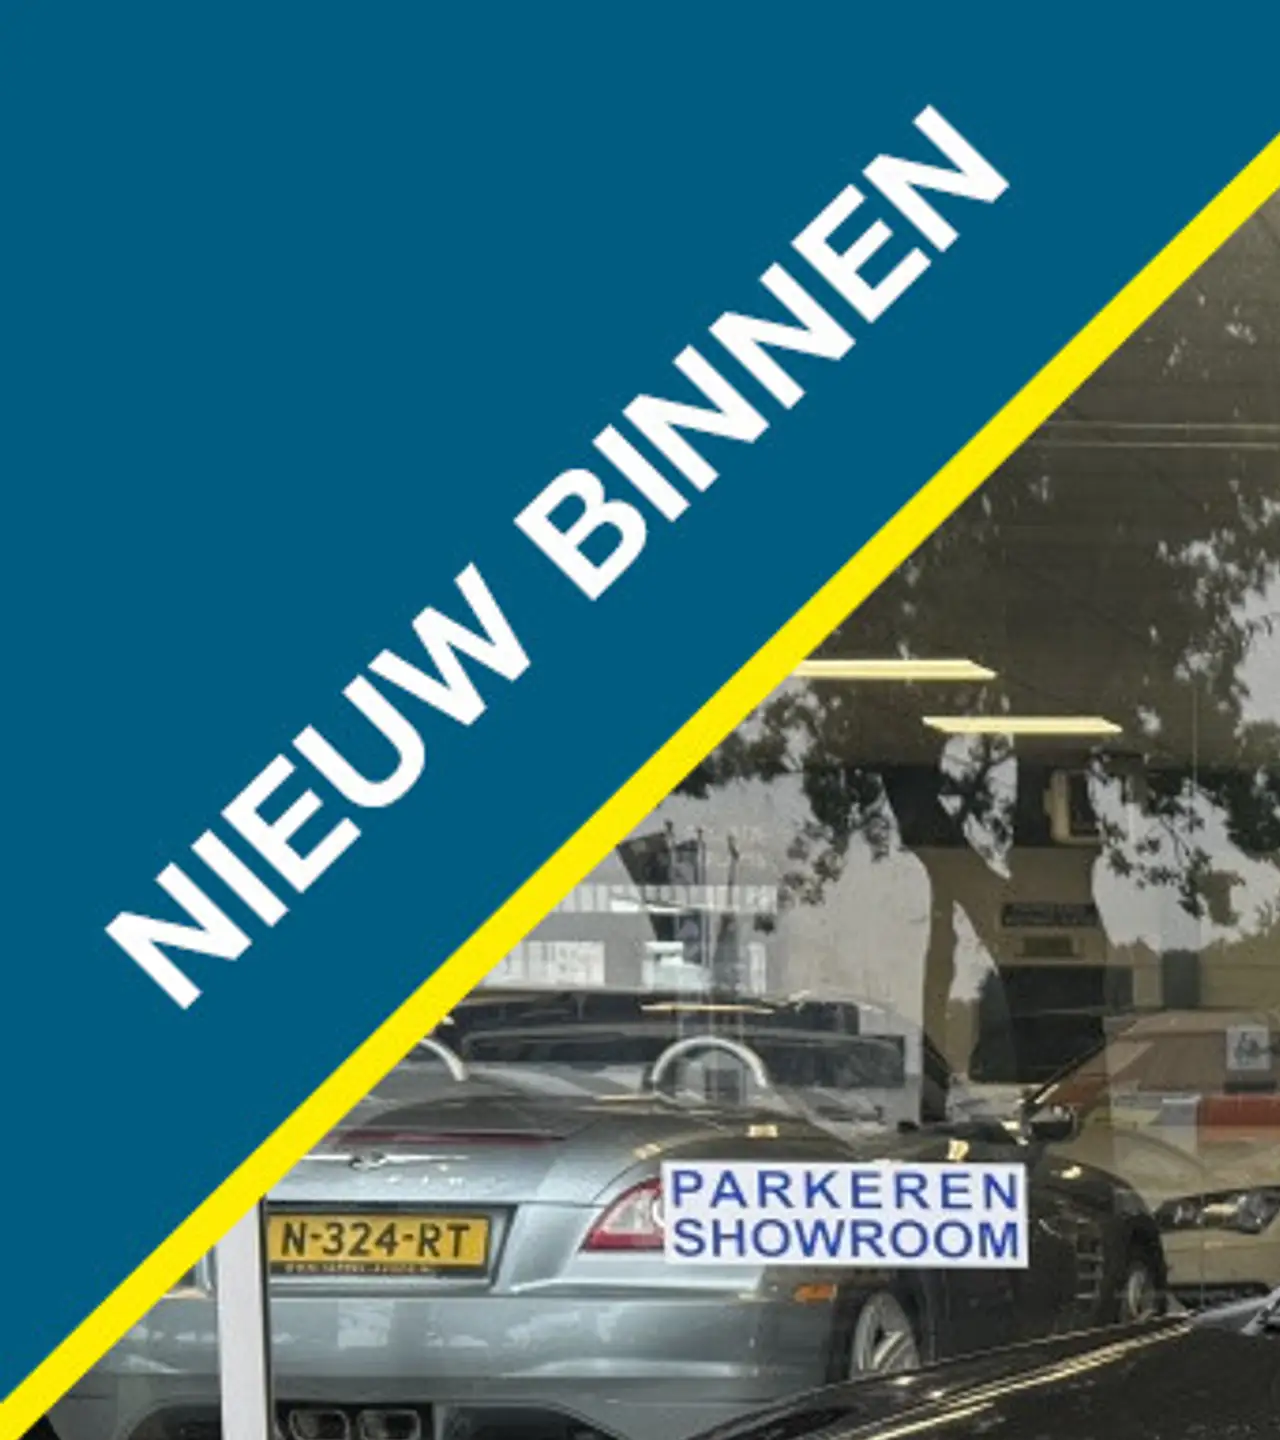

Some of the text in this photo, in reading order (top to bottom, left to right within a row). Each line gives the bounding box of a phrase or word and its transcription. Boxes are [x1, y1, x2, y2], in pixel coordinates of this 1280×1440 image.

[671, 1169, 1017, 1210] PARKEREN
[280, 1221, 471, 1259] N-324-RT
[673, 1218, 1018, 1258] SHOWROOM
